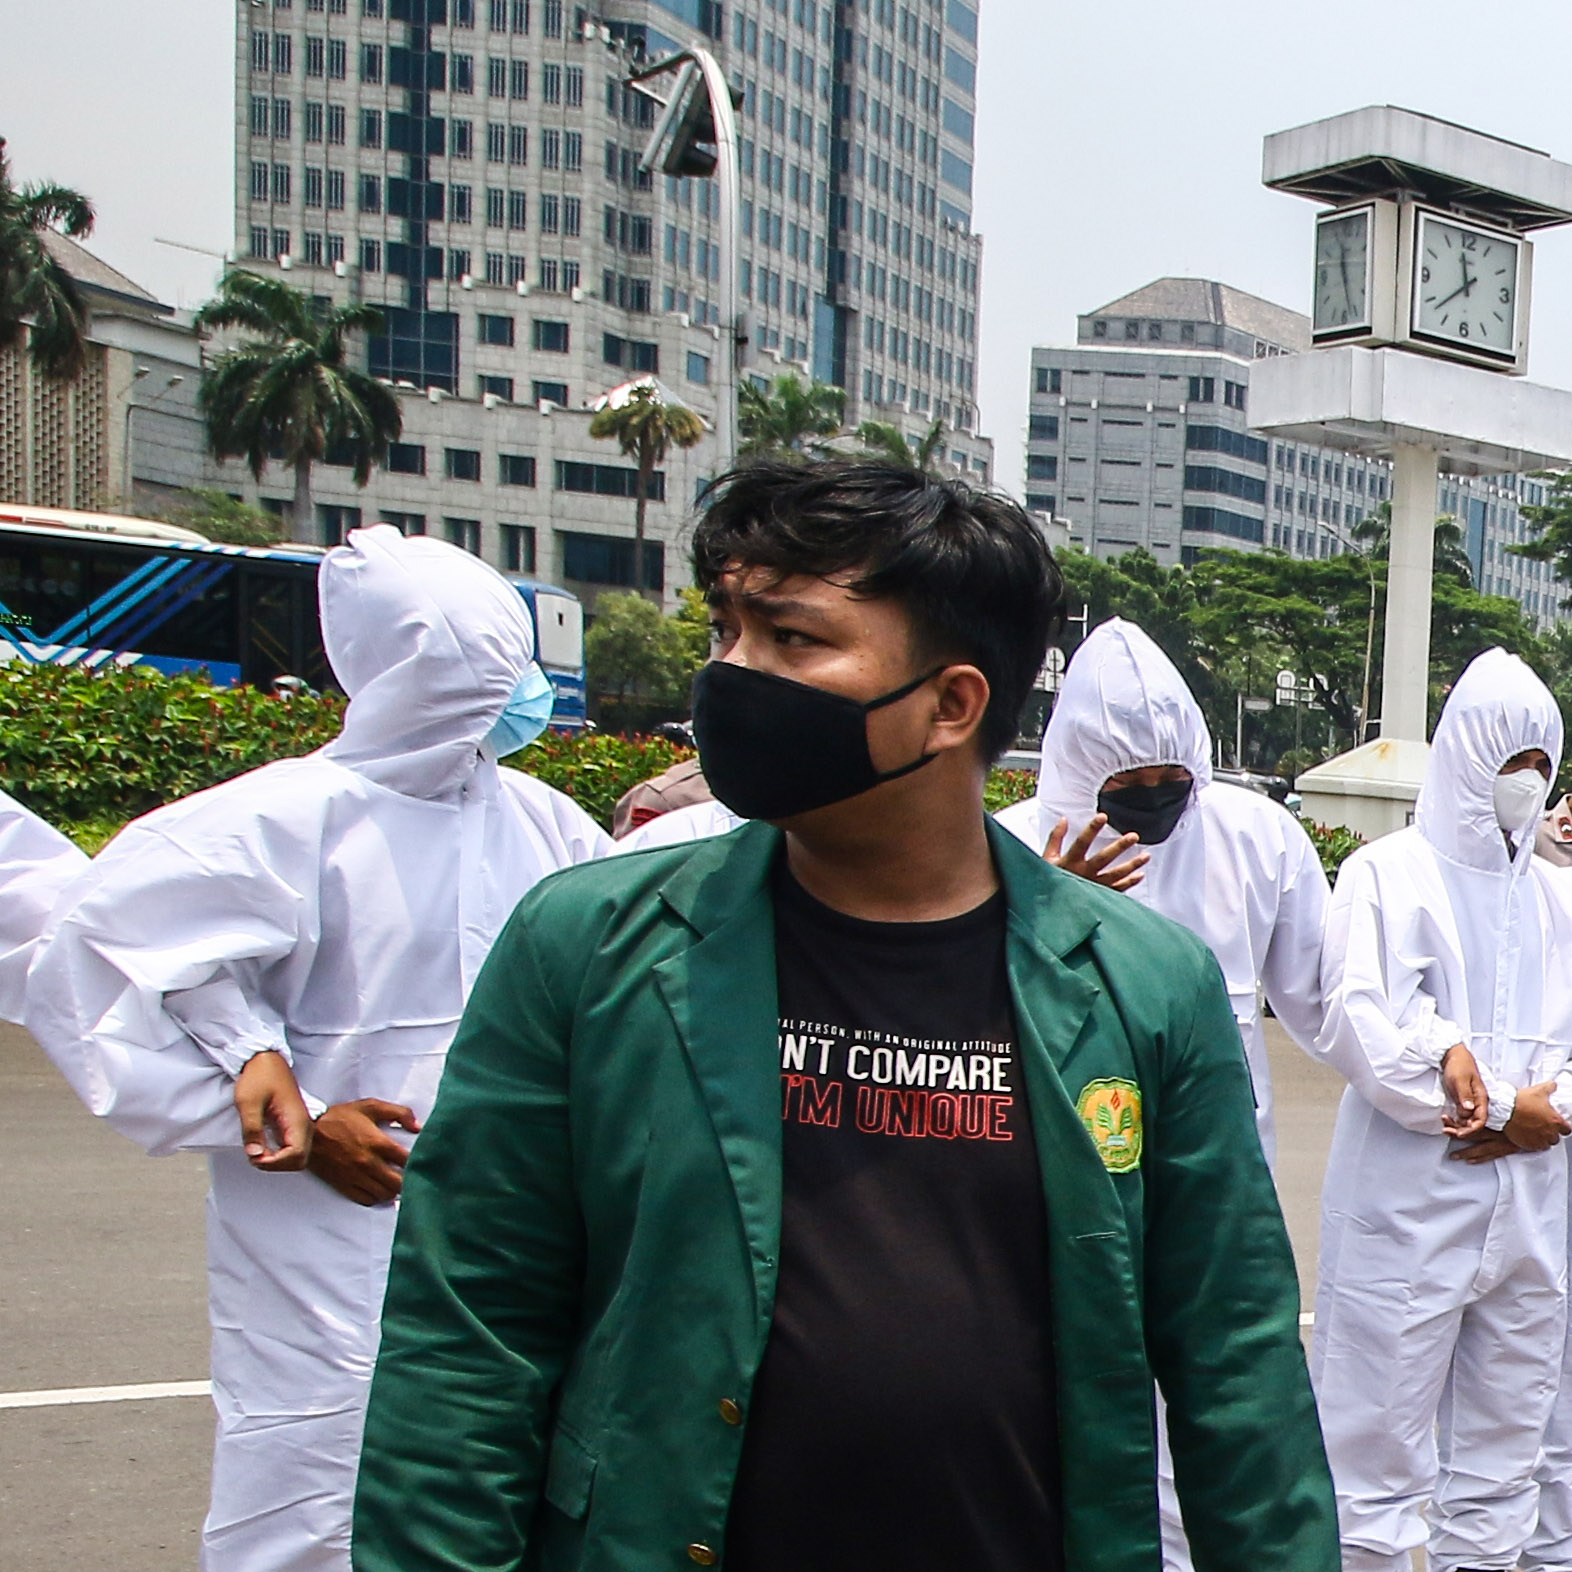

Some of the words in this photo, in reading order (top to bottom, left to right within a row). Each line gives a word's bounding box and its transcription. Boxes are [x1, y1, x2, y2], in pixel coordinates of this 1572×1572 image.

[1461, 234, 1477, 252] 12
[1421, 267, 1431, 283] 9
[1499, 288, 1510, 304] 3
[1458, 321, 1469, 338] 6
[799, 1020, 850, 1039] PERSON.
[854, 1029, 881, 1042] WITH
[885, 1033, 899, 1045] AN
[902, 1037, 957, 1052] ORIGINAL
[961, 1040, 1012, 1054] ATTITUDE
[846, 1044, 1013, 1092] COMPARE
[855, 1086, 1014, 1142] UNIQUE
